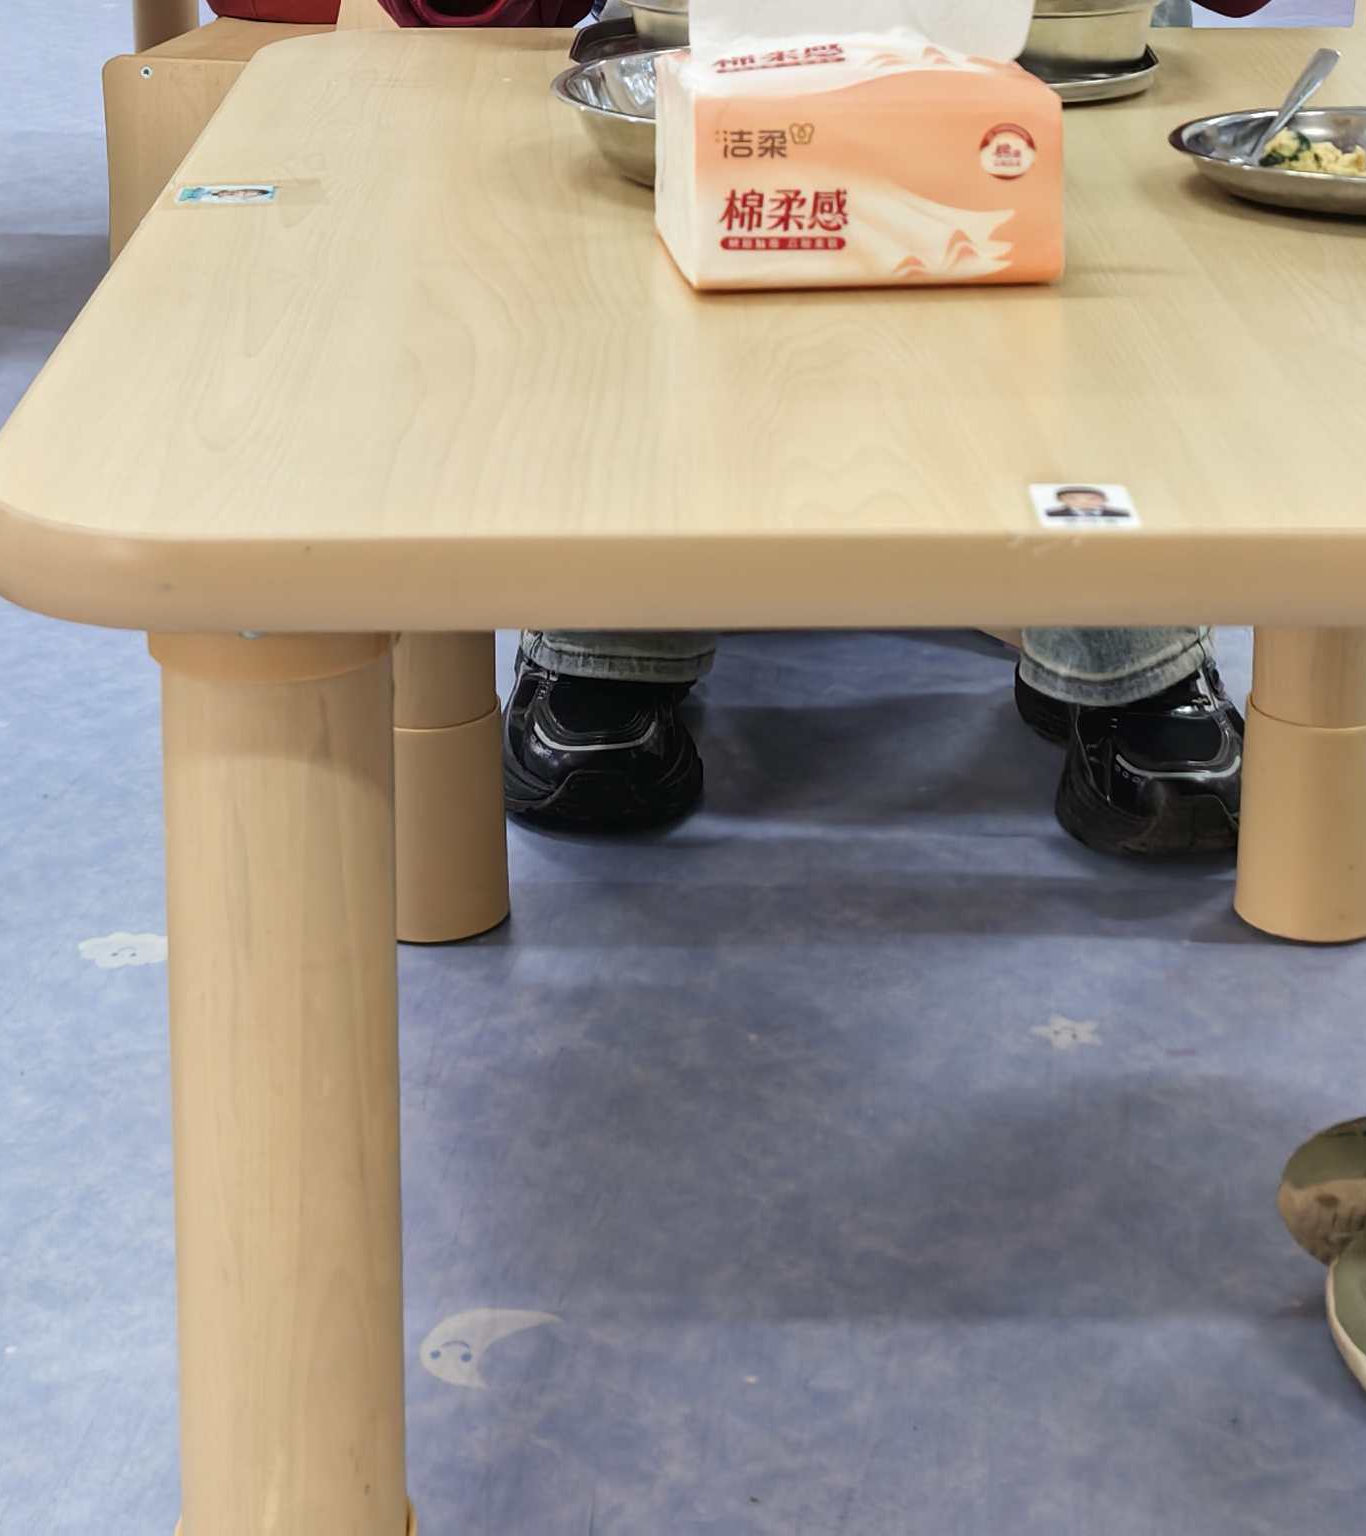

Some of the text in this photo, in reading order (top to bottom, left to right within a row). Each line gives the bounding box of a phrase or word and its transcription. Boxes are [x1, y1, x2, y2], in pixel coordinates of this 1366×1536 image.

[721, 129, 789, 159] 洁柔
[718, 187, 850, 232] 棉柔感
